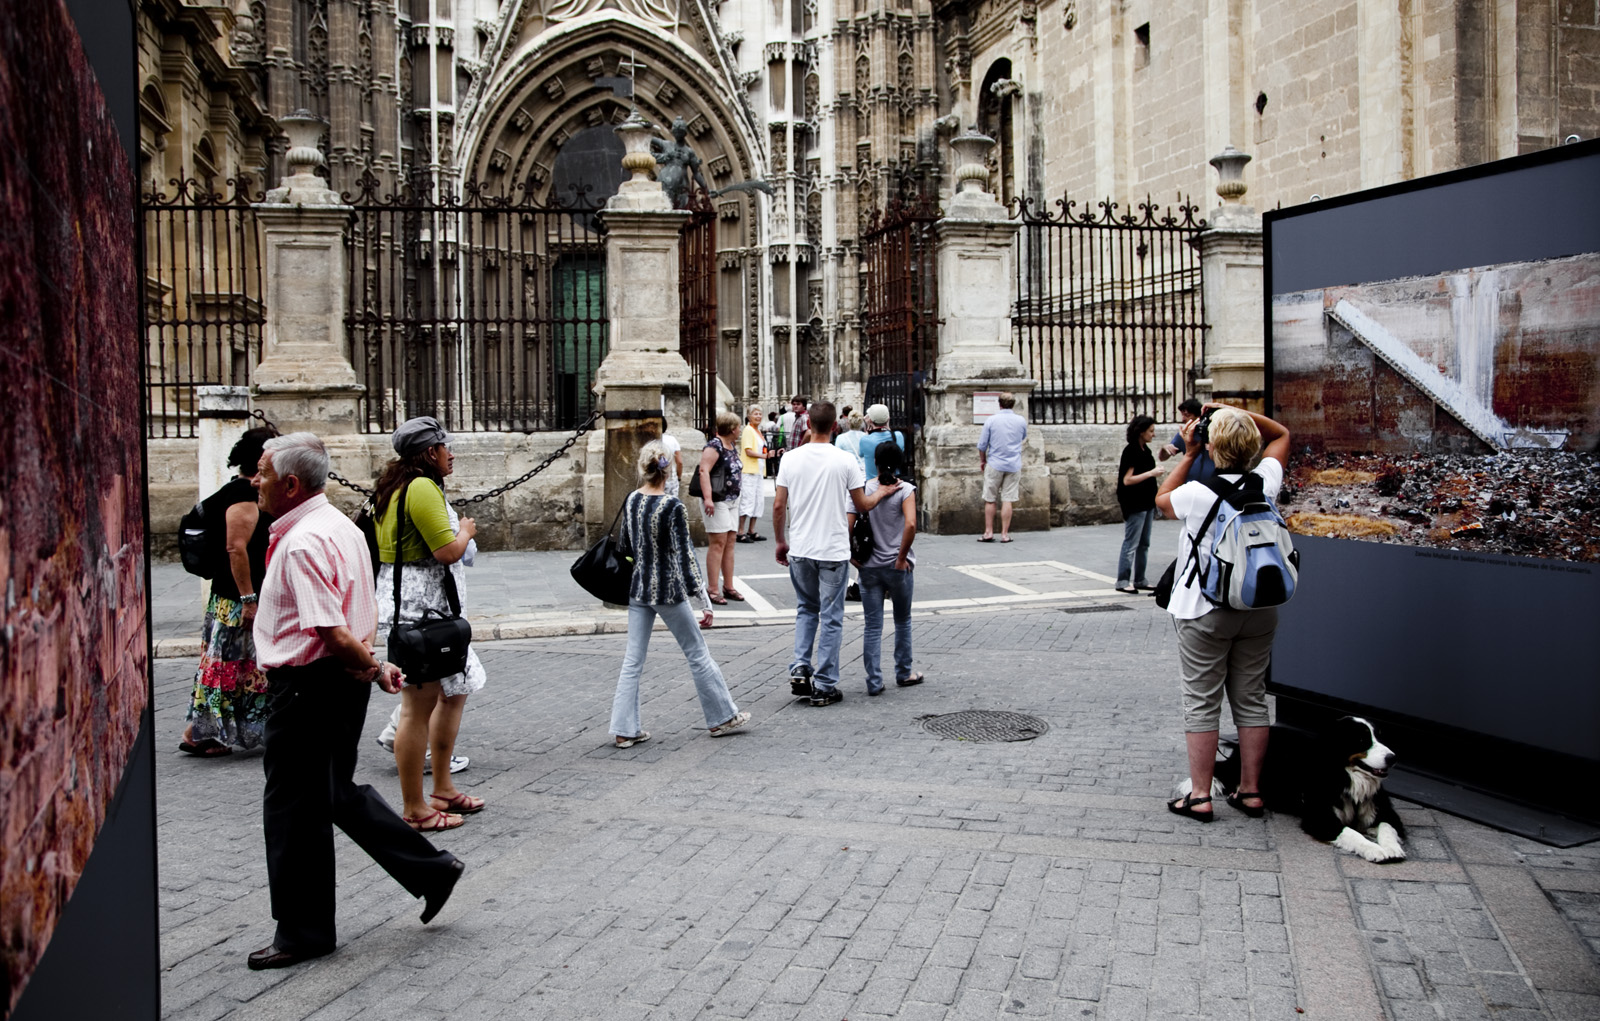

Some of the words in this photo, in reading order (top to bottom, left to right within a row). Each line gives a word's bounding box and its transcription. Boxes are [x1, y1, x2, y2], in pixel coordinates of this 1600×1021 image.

[1517, 560, 1539, 569] Palmas
[1540, 562, 1548, 570] de
[1549, 564, 1565, 572] Gran
